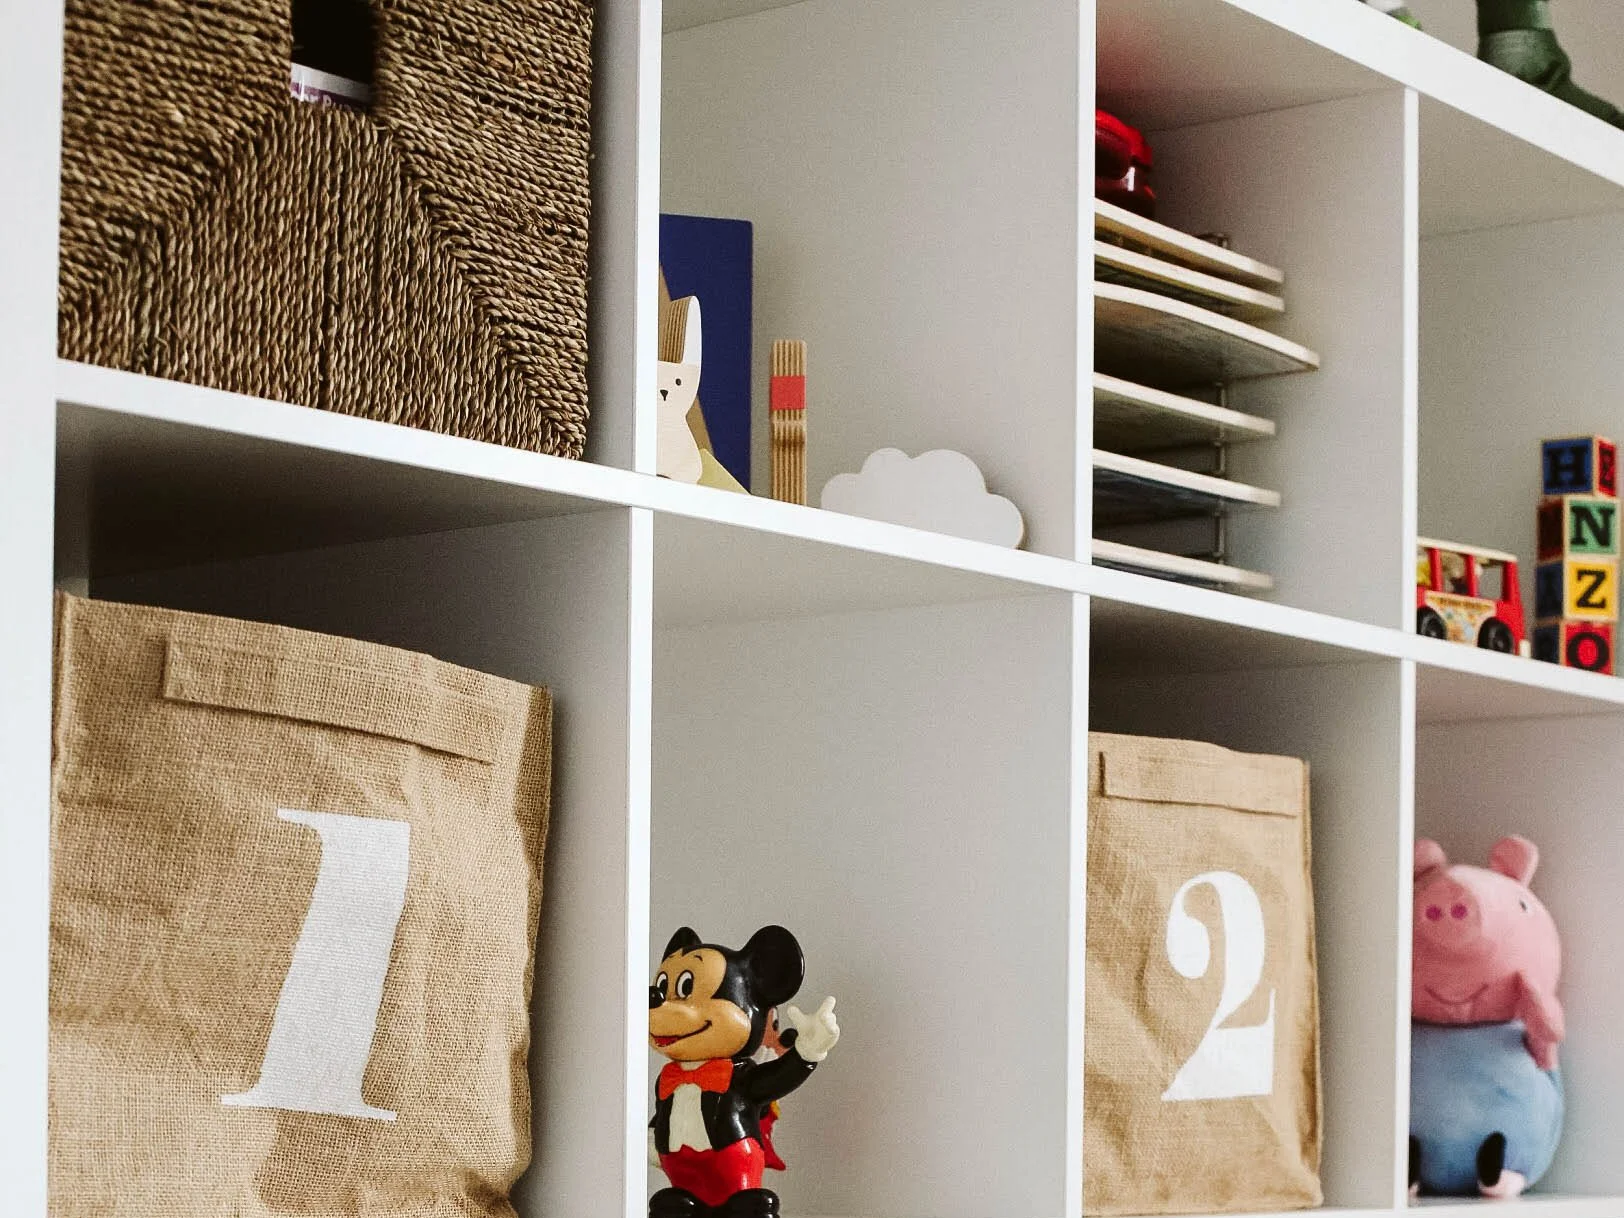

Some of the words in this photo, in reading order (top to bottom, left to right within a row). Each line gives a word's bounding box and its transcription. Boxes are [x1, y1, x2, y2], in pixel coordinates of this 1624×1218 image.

[1549, 447, 1588, 487] H
[1570, 505, 1616, 547] N
[1576, 569, 1607, 609] Z
[1567, 632, 1610, 672] O
[221, 808, 411, 1120] 1
[1161, 870, 1276, 1102] 2
